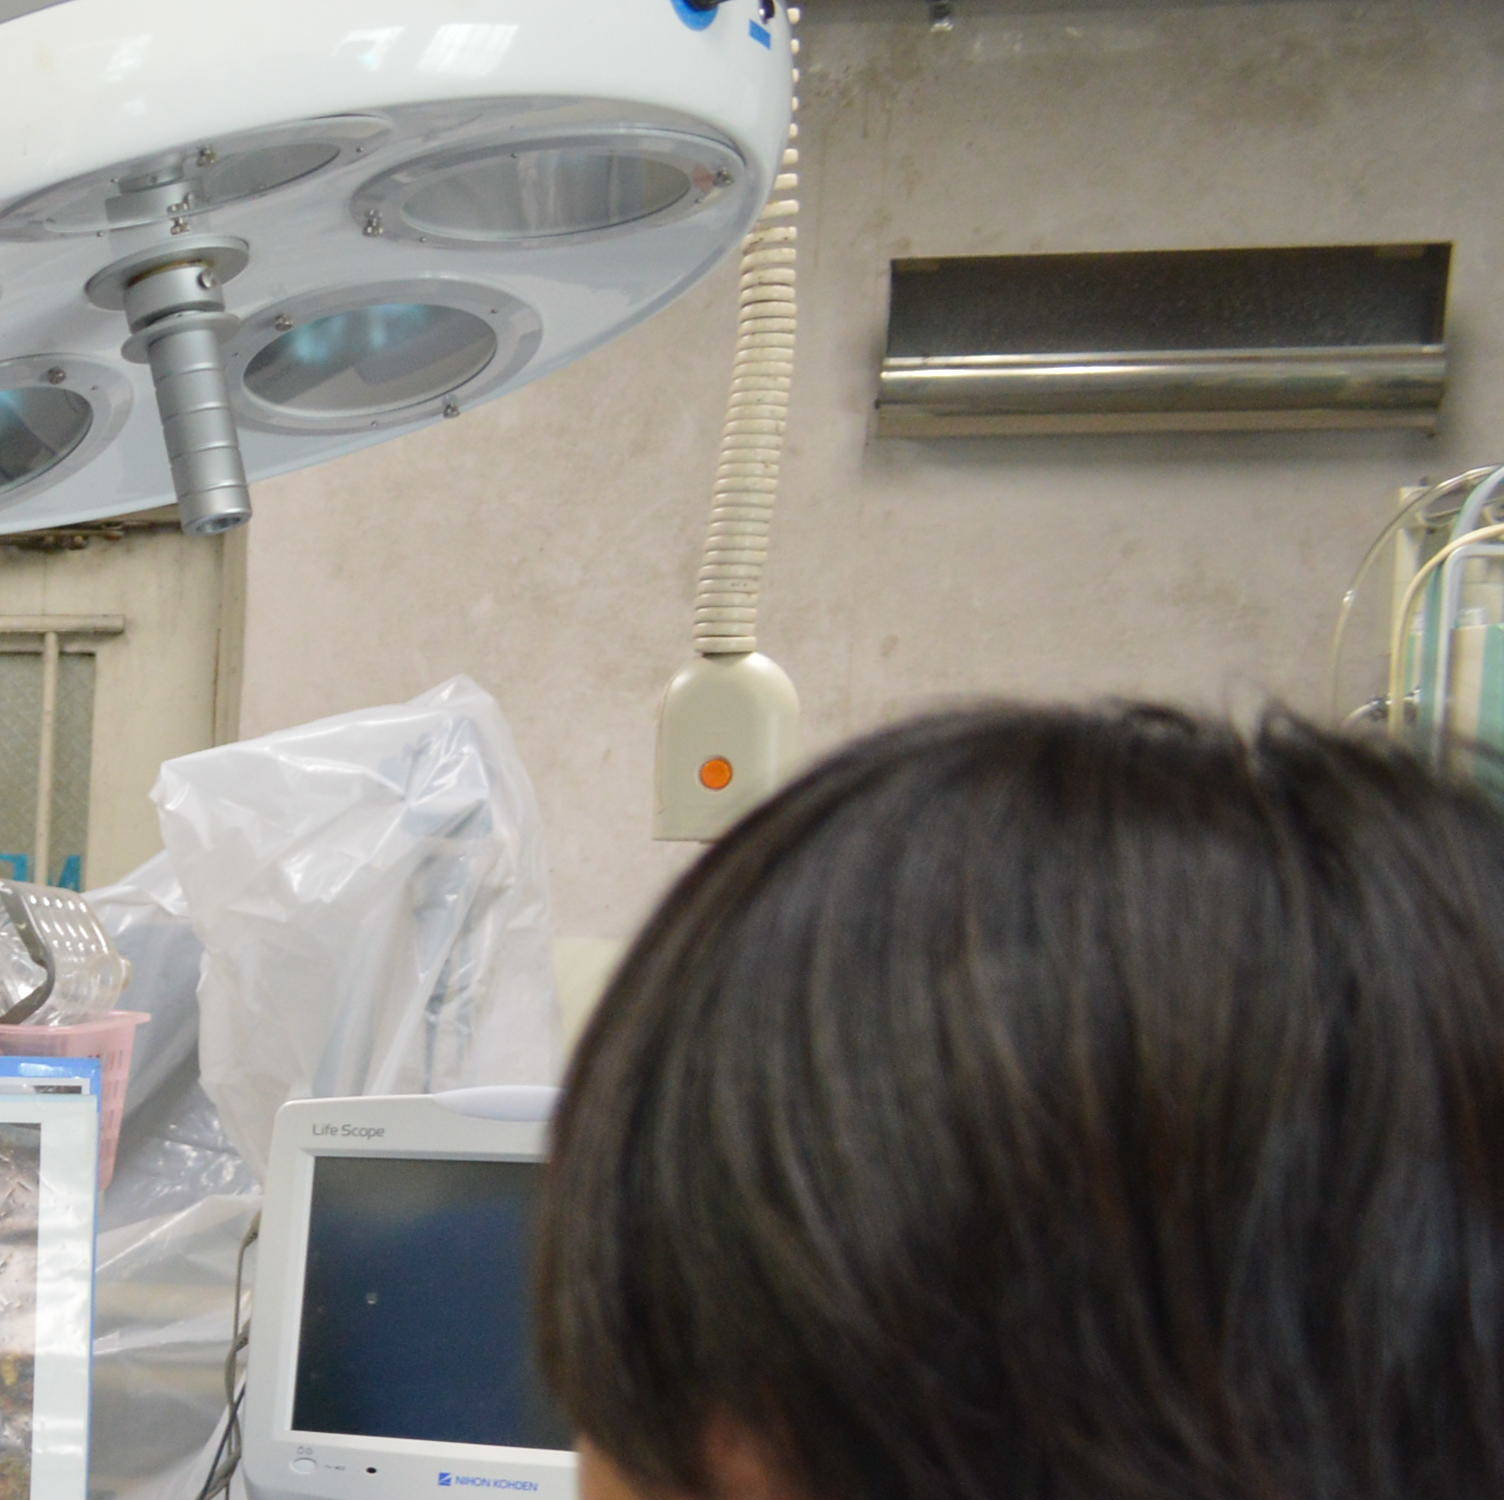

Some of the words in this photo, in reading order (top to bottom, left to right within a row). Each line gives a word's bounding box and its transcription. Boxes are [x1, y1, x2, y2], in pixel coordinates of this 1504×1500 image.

[341, 1124, 385, 1140] Scope
[455, 1475, 490, 1488] NIHON
[493, 1477, 538, 1491] KOHDEN
